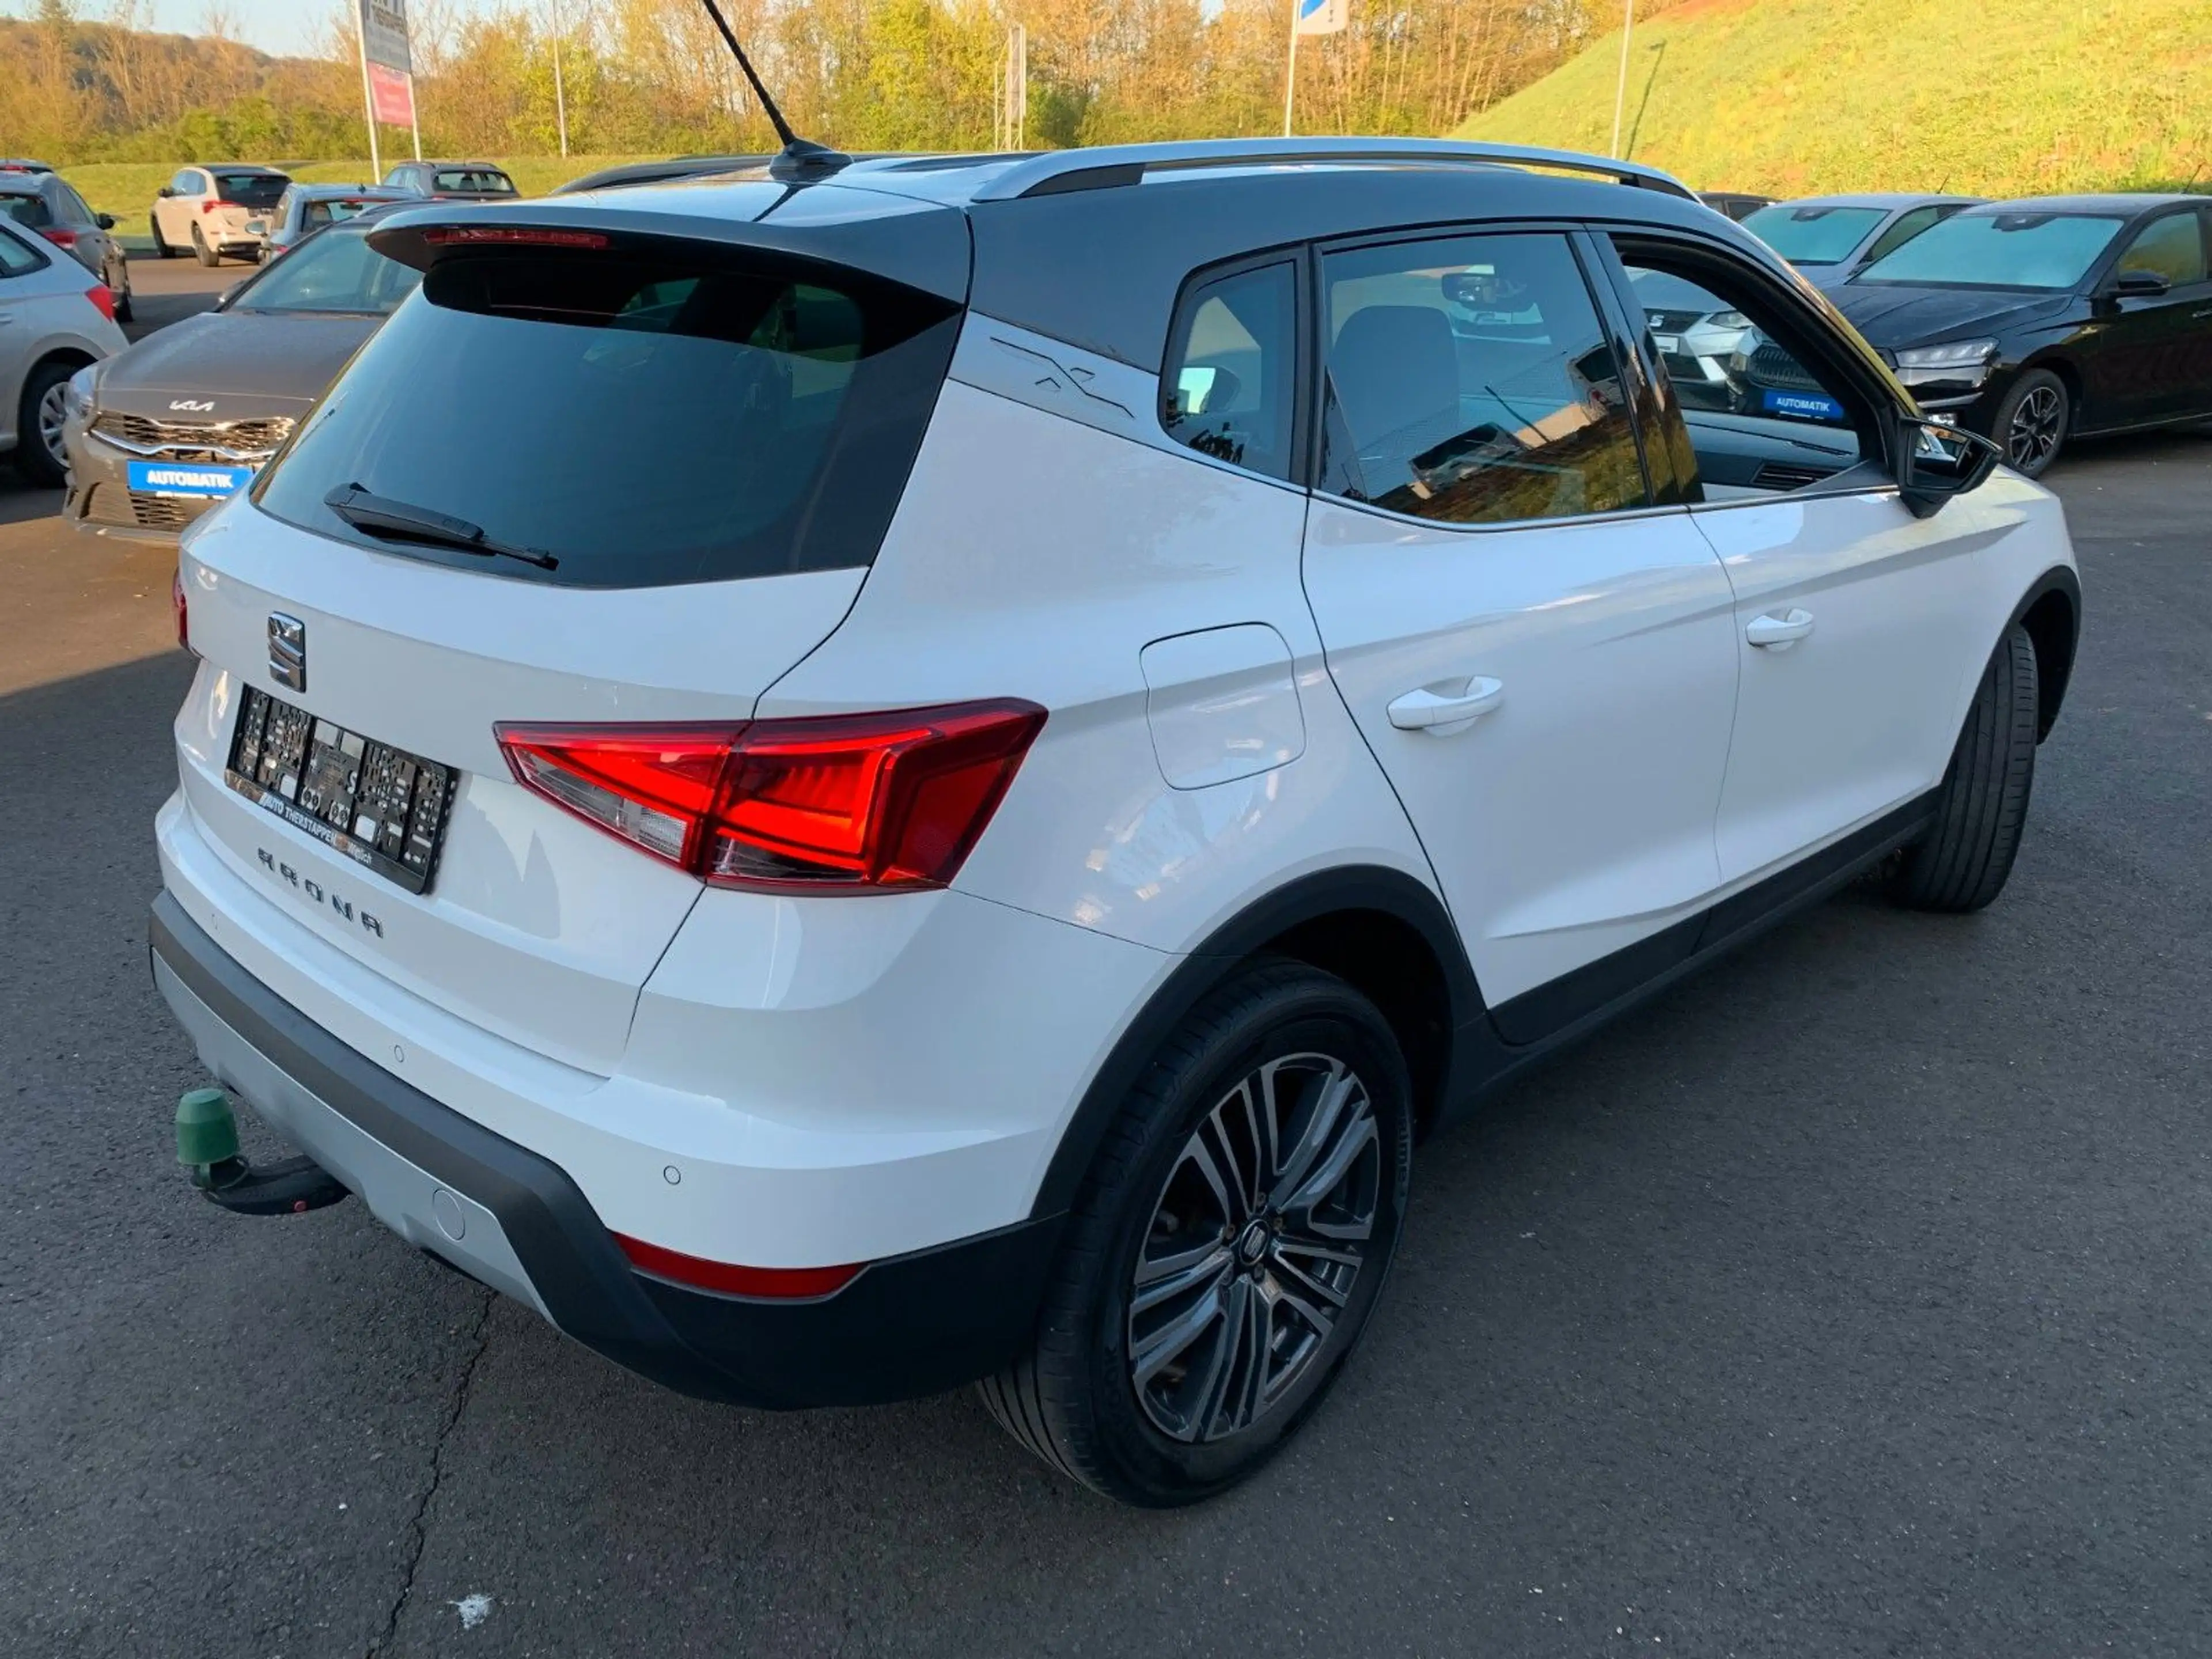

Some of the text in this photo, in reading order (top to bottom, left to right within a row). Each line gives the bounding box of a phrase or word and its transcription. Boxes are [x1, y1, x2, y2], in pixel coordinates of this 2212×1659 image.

[1777, 397, 1830, 412] AUTOMATIK
[147, 469, 233, 488] AUTOMATIK
[257, 847, 384, 940] ARONA
